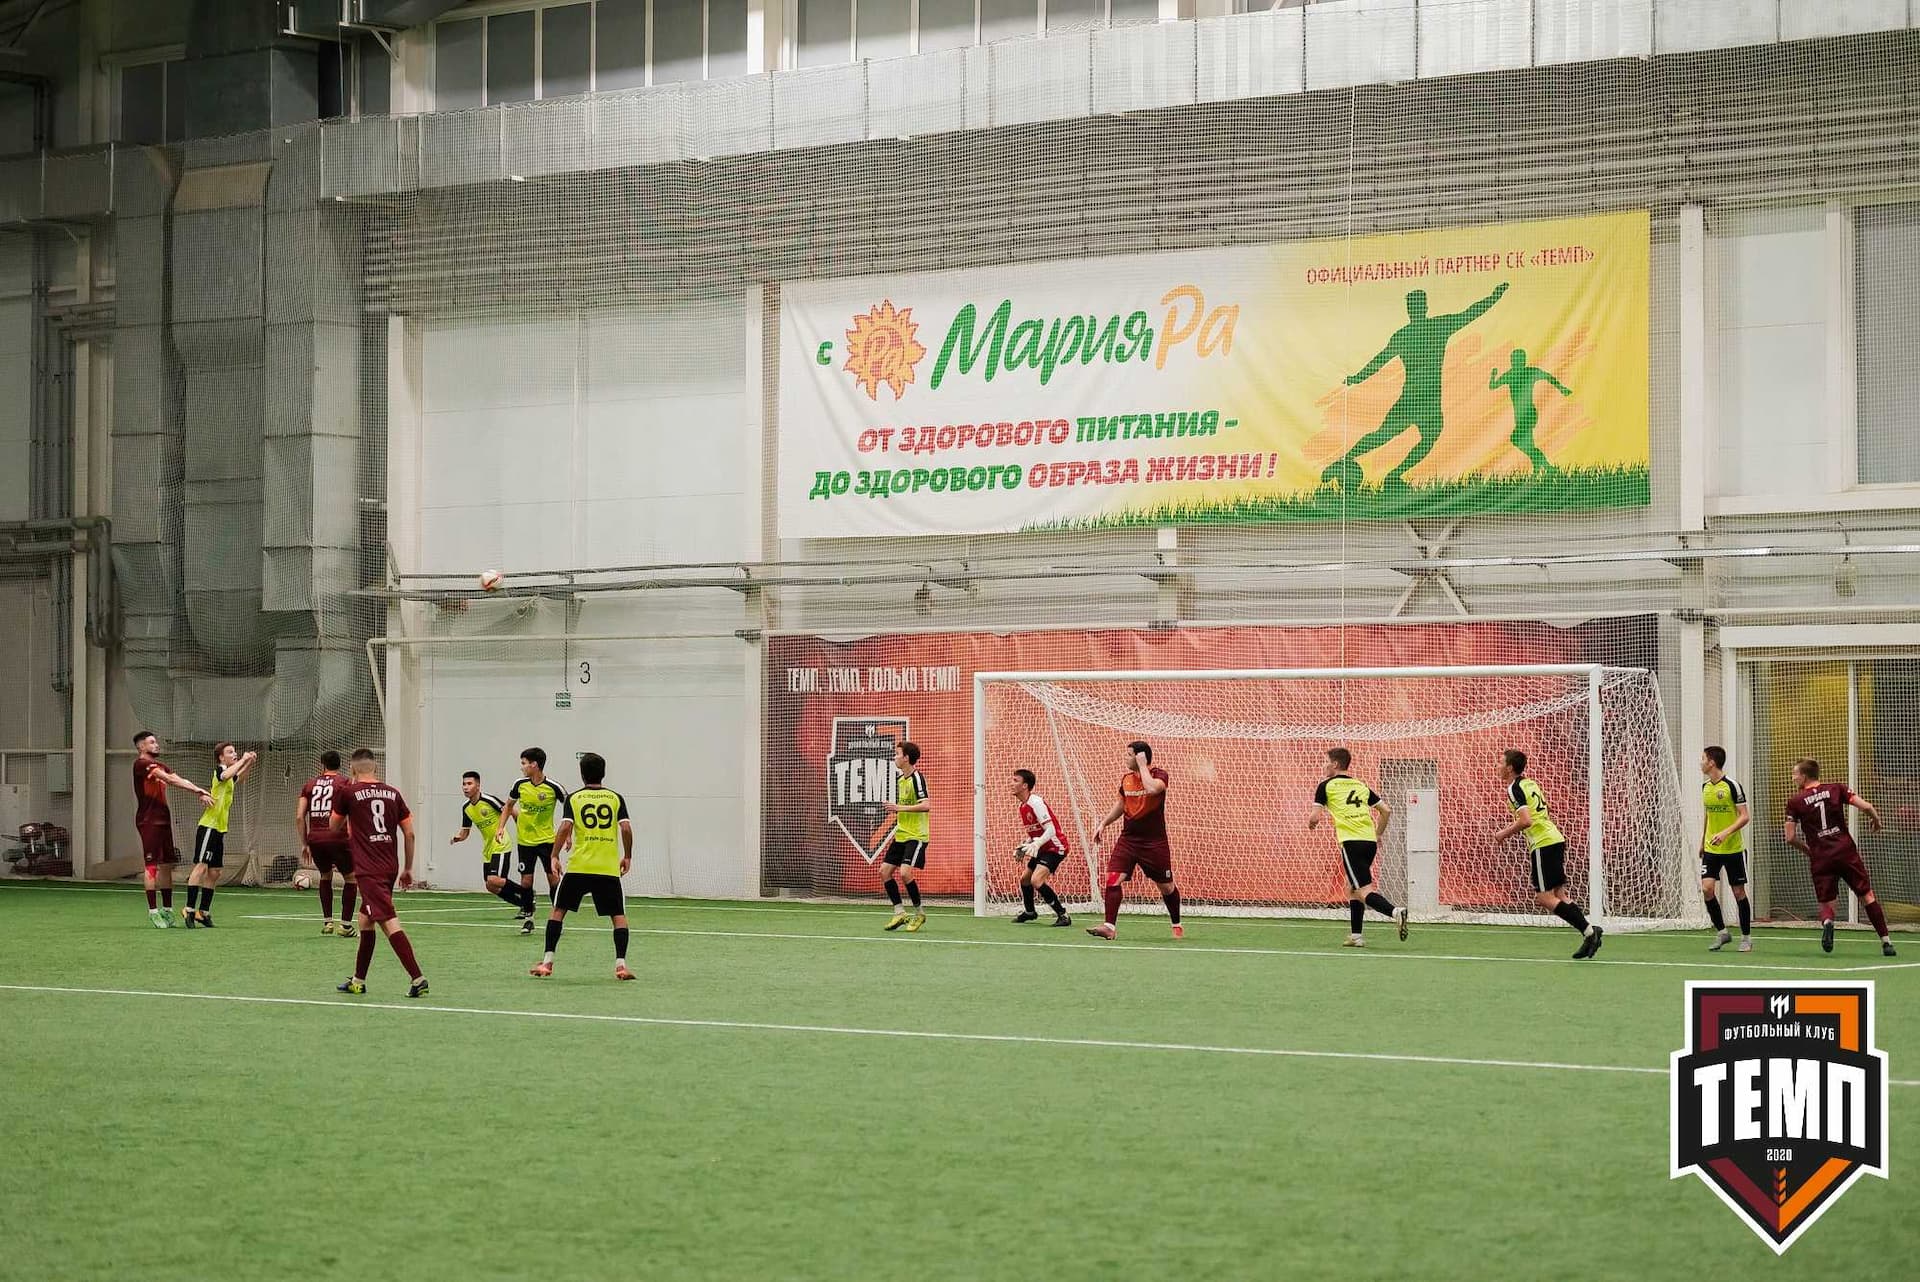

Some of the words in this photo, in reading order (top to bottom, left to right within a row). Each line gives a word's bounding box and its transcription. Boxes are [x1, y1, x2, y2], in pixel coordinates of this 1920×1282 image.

[1306, 256, 1430, 286] ОФИЦИАЛЬНЫЙ
[1435, 253, 1501, 276] ПАРТНЕР
[1505, 251, 1527, 269] СК
[1530, 245, 1595, 268] «ТЕМП»
[856, 427, 896, 454] ОТ
[897, 418, 1071, 456] ЗДОРОВОГО
[1075, 409, 1220, 444] ПИТАНИЯ
[808, 469, 852, 502] ДО
[853, 463, 1023, 500] ЗДОРОВОГО
[1027, 458, 1140, 490] ОБРАЗА
[1145, 451, 1263, 483] ЖИЗНИ
[580, 661, 591, 684] 3
[787, 667, 822, 693] ТЕМП,
[828, 667, 865, 695] ТЕМП,
[867, 666, 918, 692] ТОЛЬКО
[920, 665, 961, 691] ТЕМП!
[311, 785, 334, 812] 22
[1346, 790, 1363, 808] 4
[370, 799, 388, 834] 8
[580, 803, 613, 829] 69
